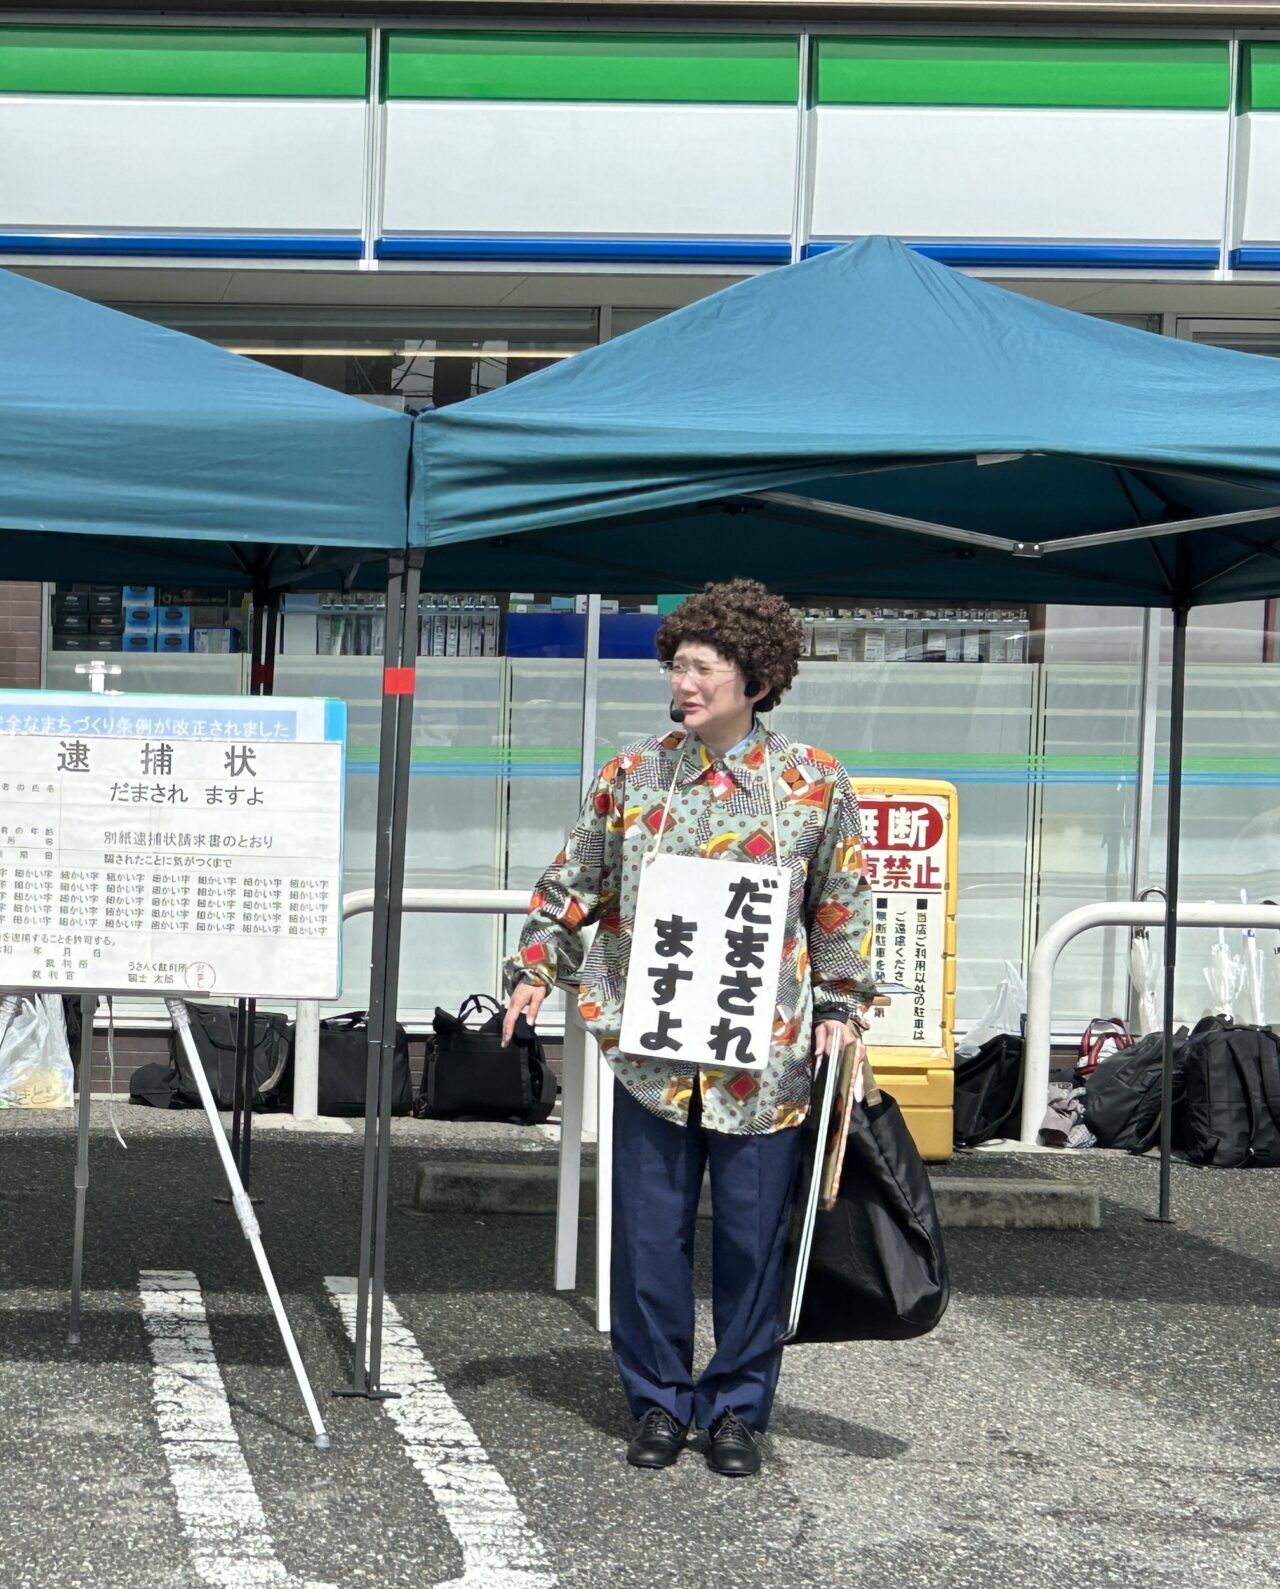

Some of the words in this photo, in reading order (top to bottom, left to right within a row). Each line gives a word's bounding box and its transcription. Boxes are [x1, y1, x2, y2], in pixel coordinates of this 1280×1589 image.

[57, 740, 257, 777] 逮捕状
[110, 782, 189, 805] だまされ
[205, 785, 264, 806] ますよ
[639, 913, 698, 1052] ますよ
[706, 876, 780, 1064] だまされ
